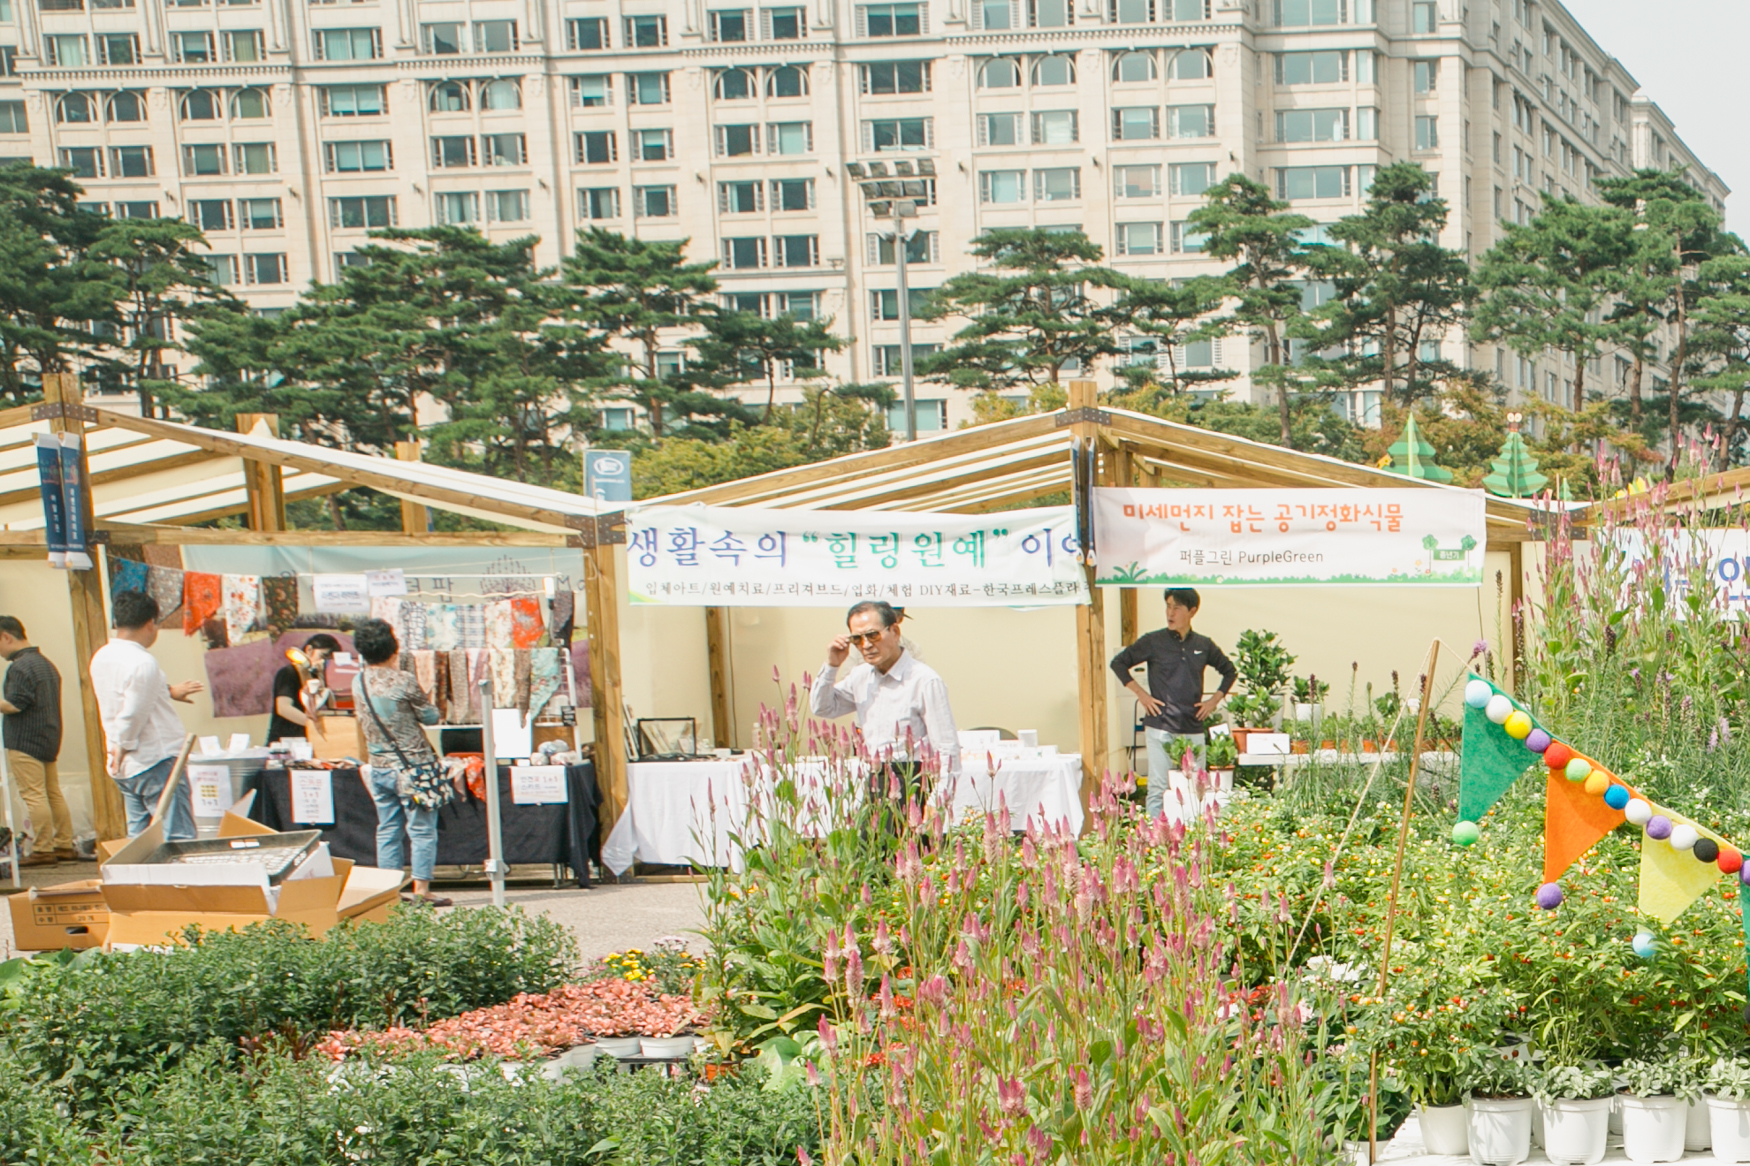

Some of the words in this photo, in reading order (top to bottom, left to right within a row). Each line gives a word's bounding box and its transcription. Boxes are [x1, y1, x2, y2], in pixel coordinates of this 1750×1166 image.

[1123, 504, 1213, 532] 미세먼지
[1223, 504, 1265, 533] 잡는
[1274, 503, 1403, 533] 공기정화식물
[627, 527, 787, 568] 생활속의
[1180, 549, 1232, 565] 퍼플그린
[1238, 550, 1324, 565] PurpleGreen
